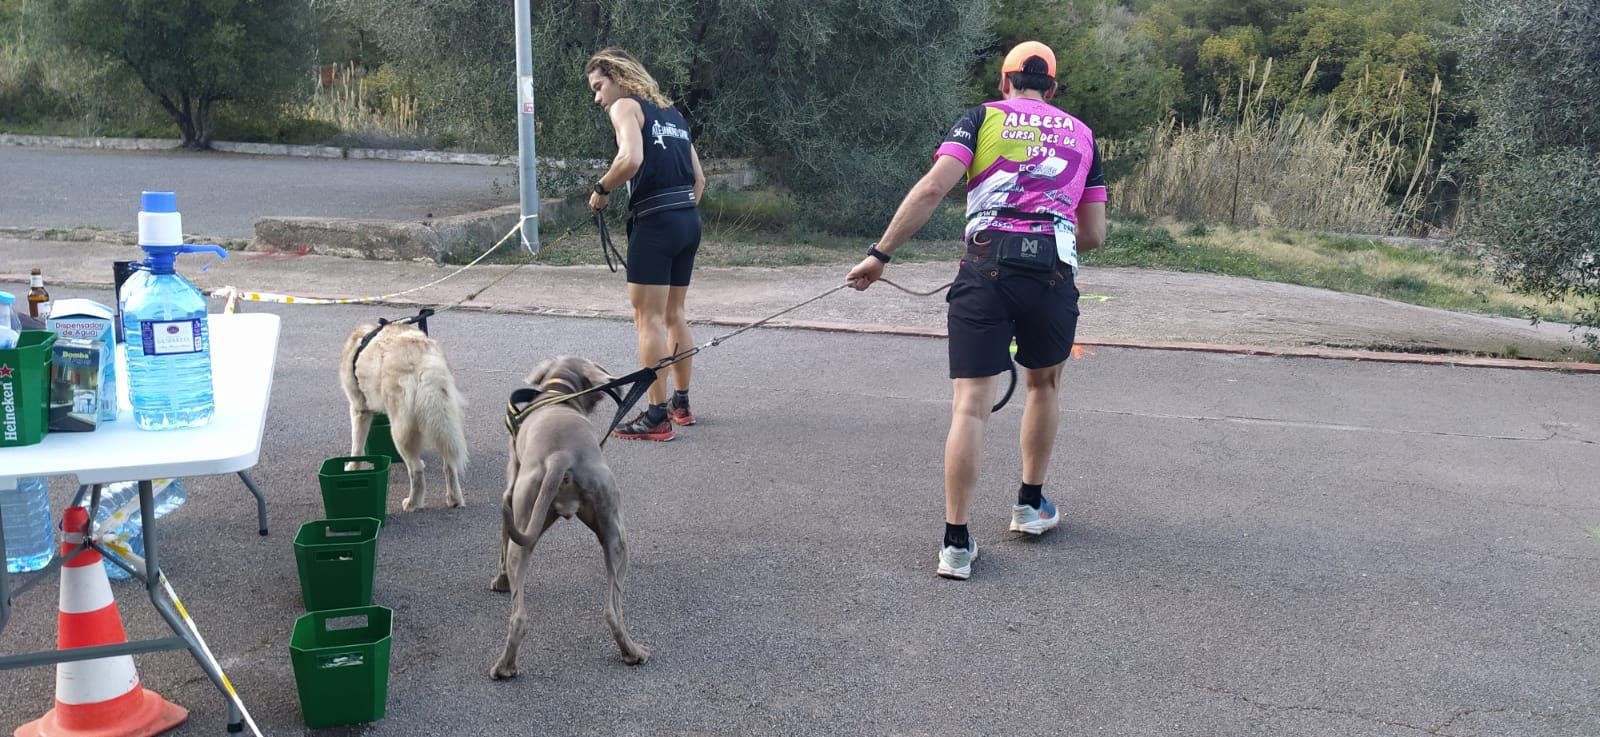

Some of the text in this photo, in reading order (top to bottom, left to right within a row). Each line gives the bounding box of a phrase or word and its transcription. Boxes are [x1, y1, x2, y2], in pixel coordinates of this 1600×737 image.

[1005, 112, 1074, 131] ALBESA
[1002, 130, 1076, 147] CURSA DES DE
[1027, 146, 1056, 157] 1590
[62, 329, 73, 337] de
[1, 382, 17, 441] Heineken
